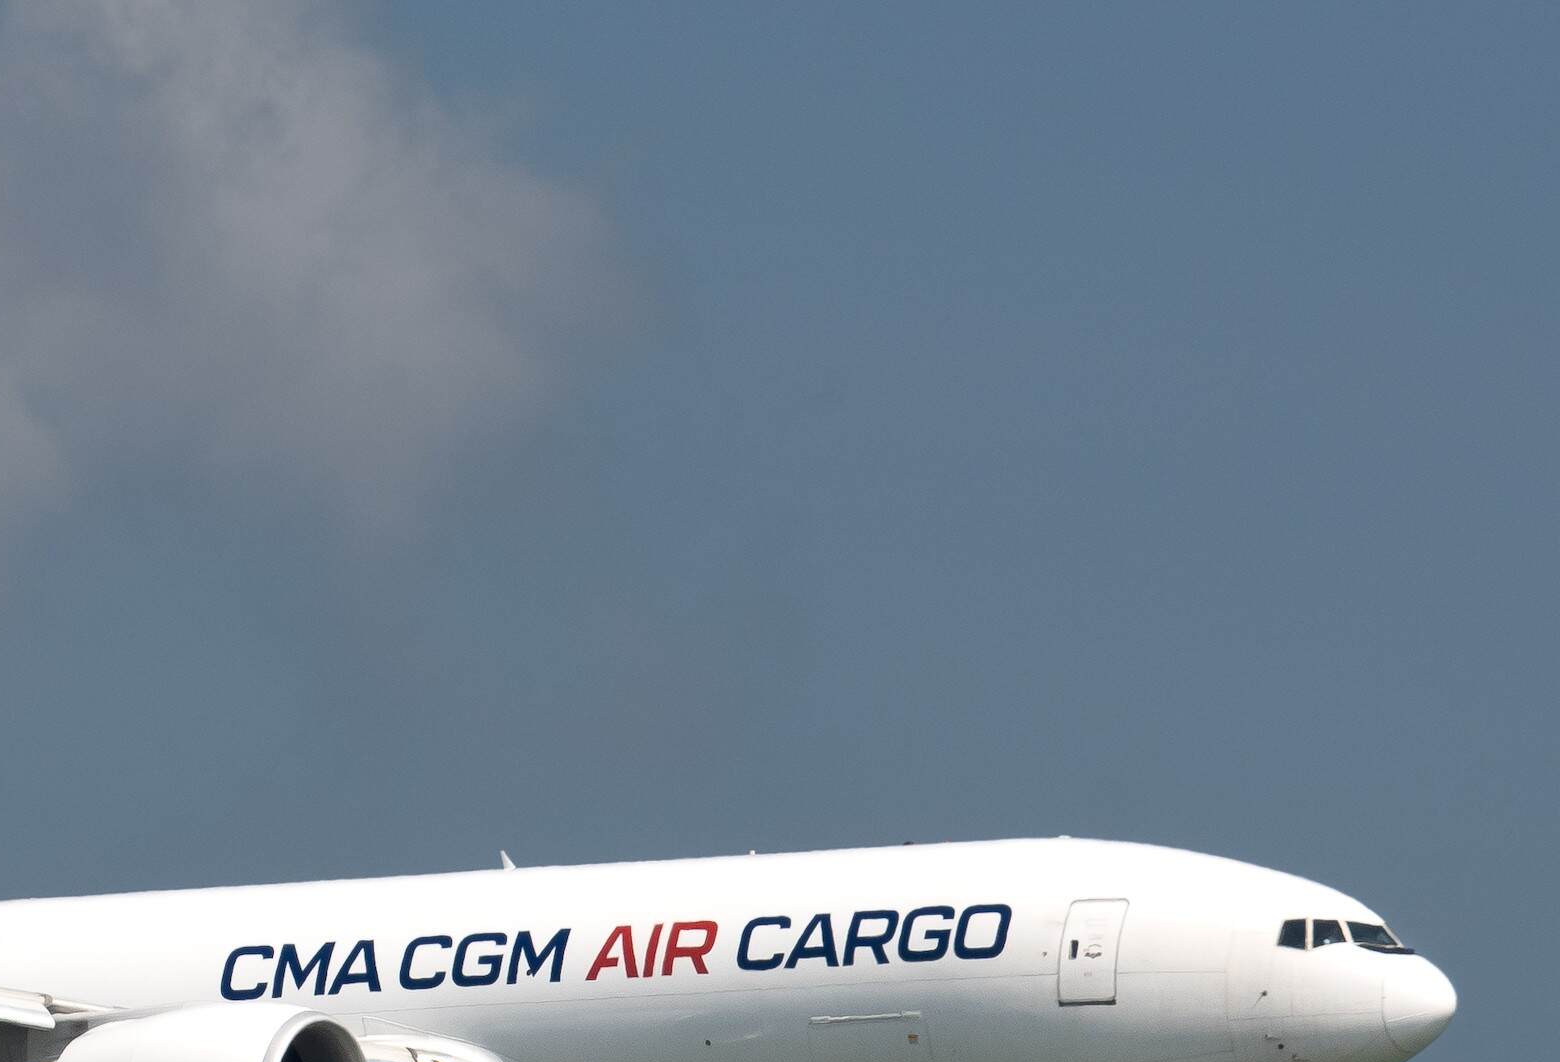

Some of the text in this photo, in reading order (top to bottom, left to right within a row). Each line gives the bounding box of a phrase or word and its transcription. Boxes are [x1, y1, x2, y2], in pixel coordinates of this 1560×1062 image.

[220, 903, 1013, 1001] CMA CGM AIR CARGO
